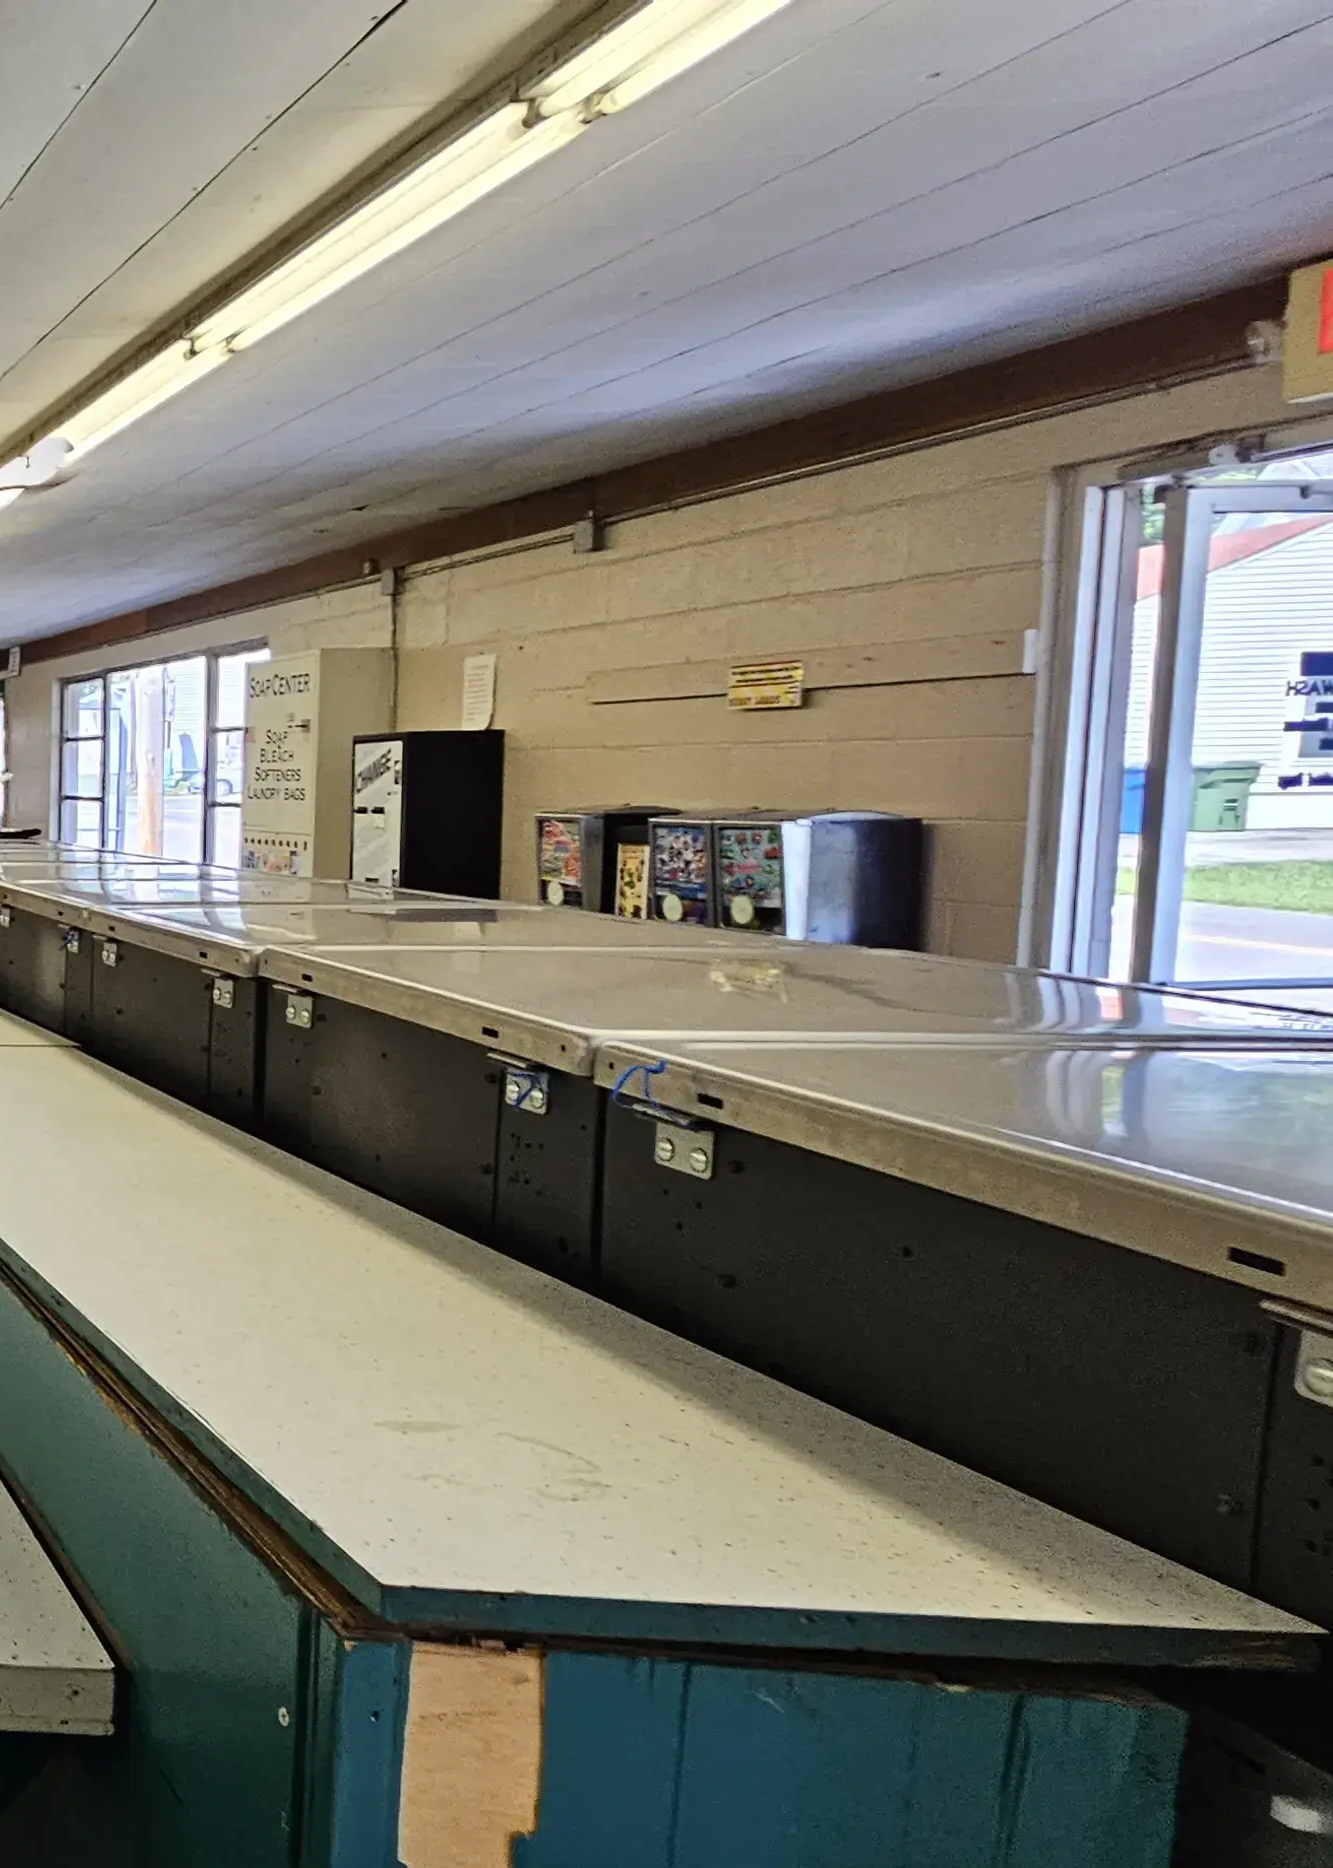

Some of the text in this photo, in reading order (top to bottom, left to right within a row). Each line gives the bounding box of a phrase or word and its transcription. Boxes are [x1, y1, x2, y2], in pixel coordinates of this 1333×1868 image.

[260, 748, 294, 764] BLEACH
[254, 766, 301, 782] SOFTENERS
[283, 787, 306, 801] BAGS
